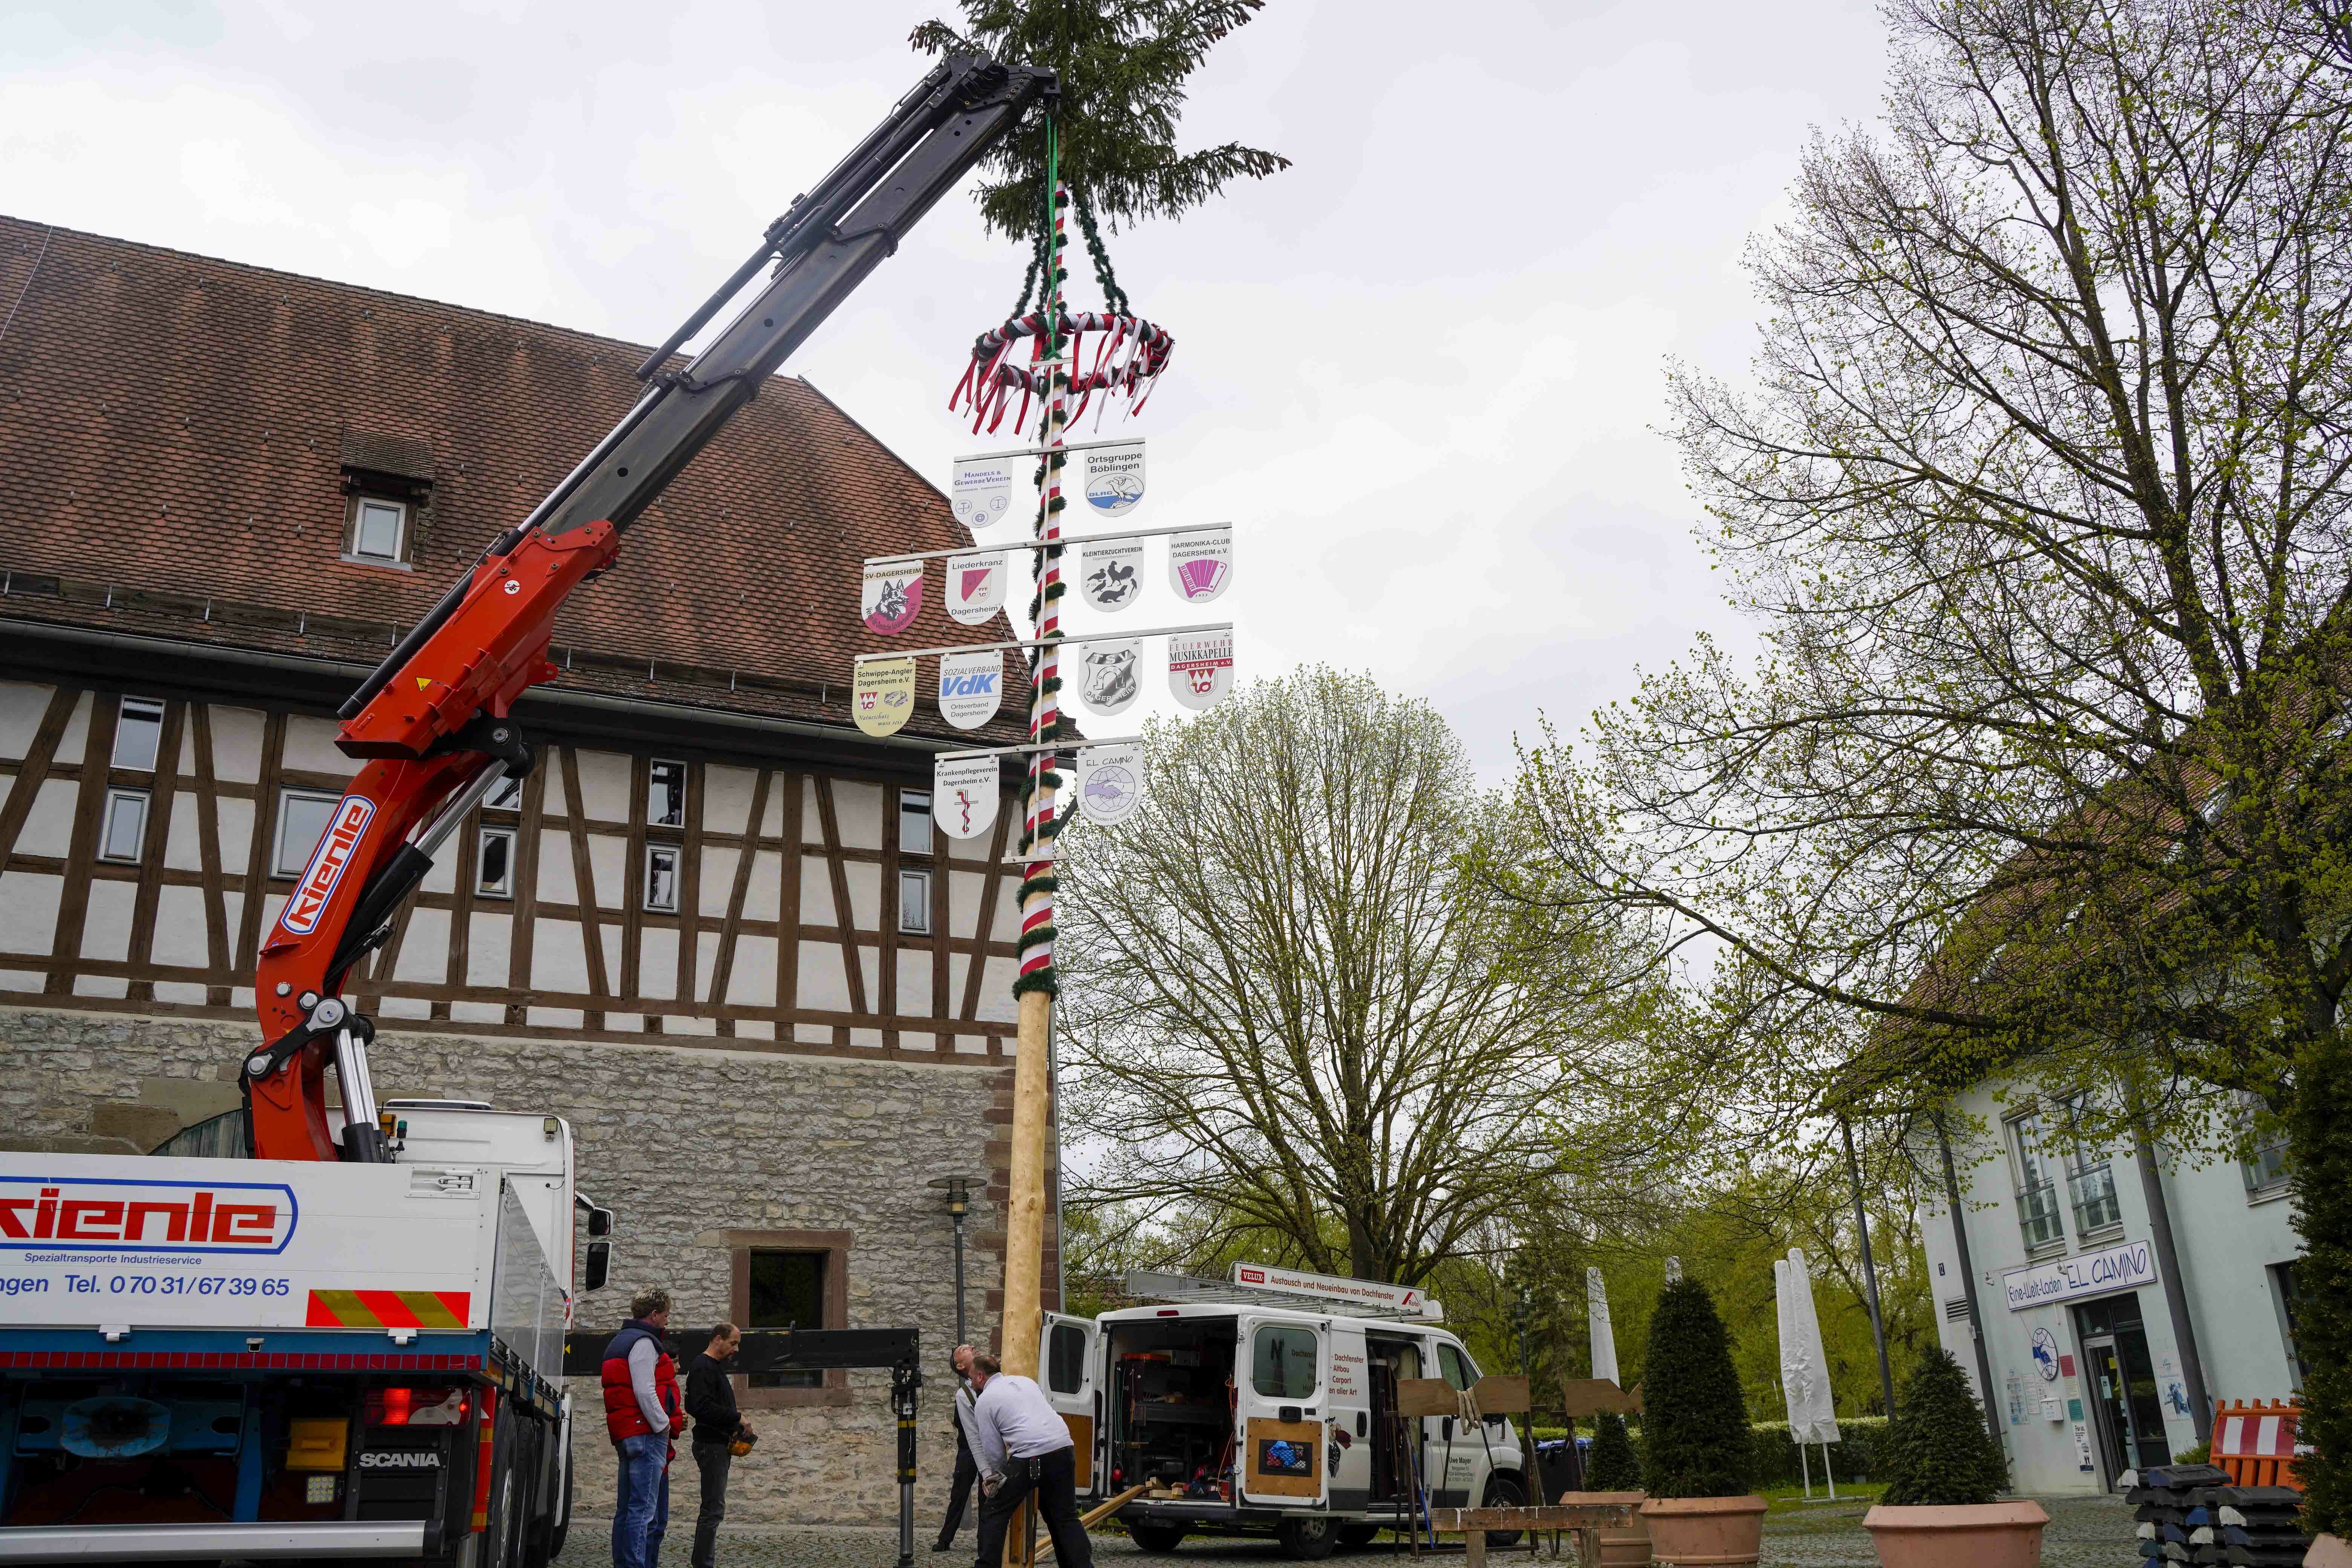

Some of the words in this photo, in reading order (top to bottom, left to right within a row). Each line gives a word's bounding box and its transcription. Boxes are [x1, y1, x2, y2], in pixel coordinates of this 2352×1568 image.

[1087, 453, 1142, 463] Ortsgruppe
[1090, 463, 1139, 473] Böblingen
[1171, 538, 1230, 549] HARMONIKA-CLUB
[1083, 547, 1142, 557] KLEINTIERZUCHTVEREIN
[1173, 549, 1216, 557] DAGERSHEIM
[952, 560, 1003, 570] Liederkranz
[865, 568, 922, 579] SV-DAGERSHEIM
[951, 606, 998, 616] Dagersheim
[1170, 639, 1233, 652] FEUERWEHR
[1093, 651, 1128, 664] TSV
[1170, 647, 1233, 662] MUSIKKAPELLE
[943, 665, 1001, 676] SOZIALVERBAND
[1171, 661, 1219, 670] DAGERSHEIM
[858, 668, 913, 678] Schwippe-Angler
[858, 678, 897, 687] Dagersheim
[942, 673, 998, 697] VdK
[859, 712, 890, 720] Naturschutz
[1102, 755, 1133, 765] CAMINO
[937, 766, 997, 777] Krankenpflegeverein
[24, 1253, 117, 1264] Spezialtransporte
[121, 1255, 202, 1265] Industrieservice
[2009, 1276, 2063, 1302] Eine-Welt-Laden
[2067, 1263, 2090, 1289] EL
[2092, 1245, 2146, 1284] CAMINO
[65, 1275, 100, 1292] Tel.
[1243, 1272, 1263, 1281] VELUX
[1271, 1276, 1301, 1287] Austausch
[1317, 1282, 1348, 1294] Neueinbau
[1362, 1289, 1394, 1300] Dachfenster
[1335, 1354, 1364, 1363] Dachfenster
[1332, 1376, 1351, 1385] Carport
[359, 1453, 440, 1467] SCANIA
